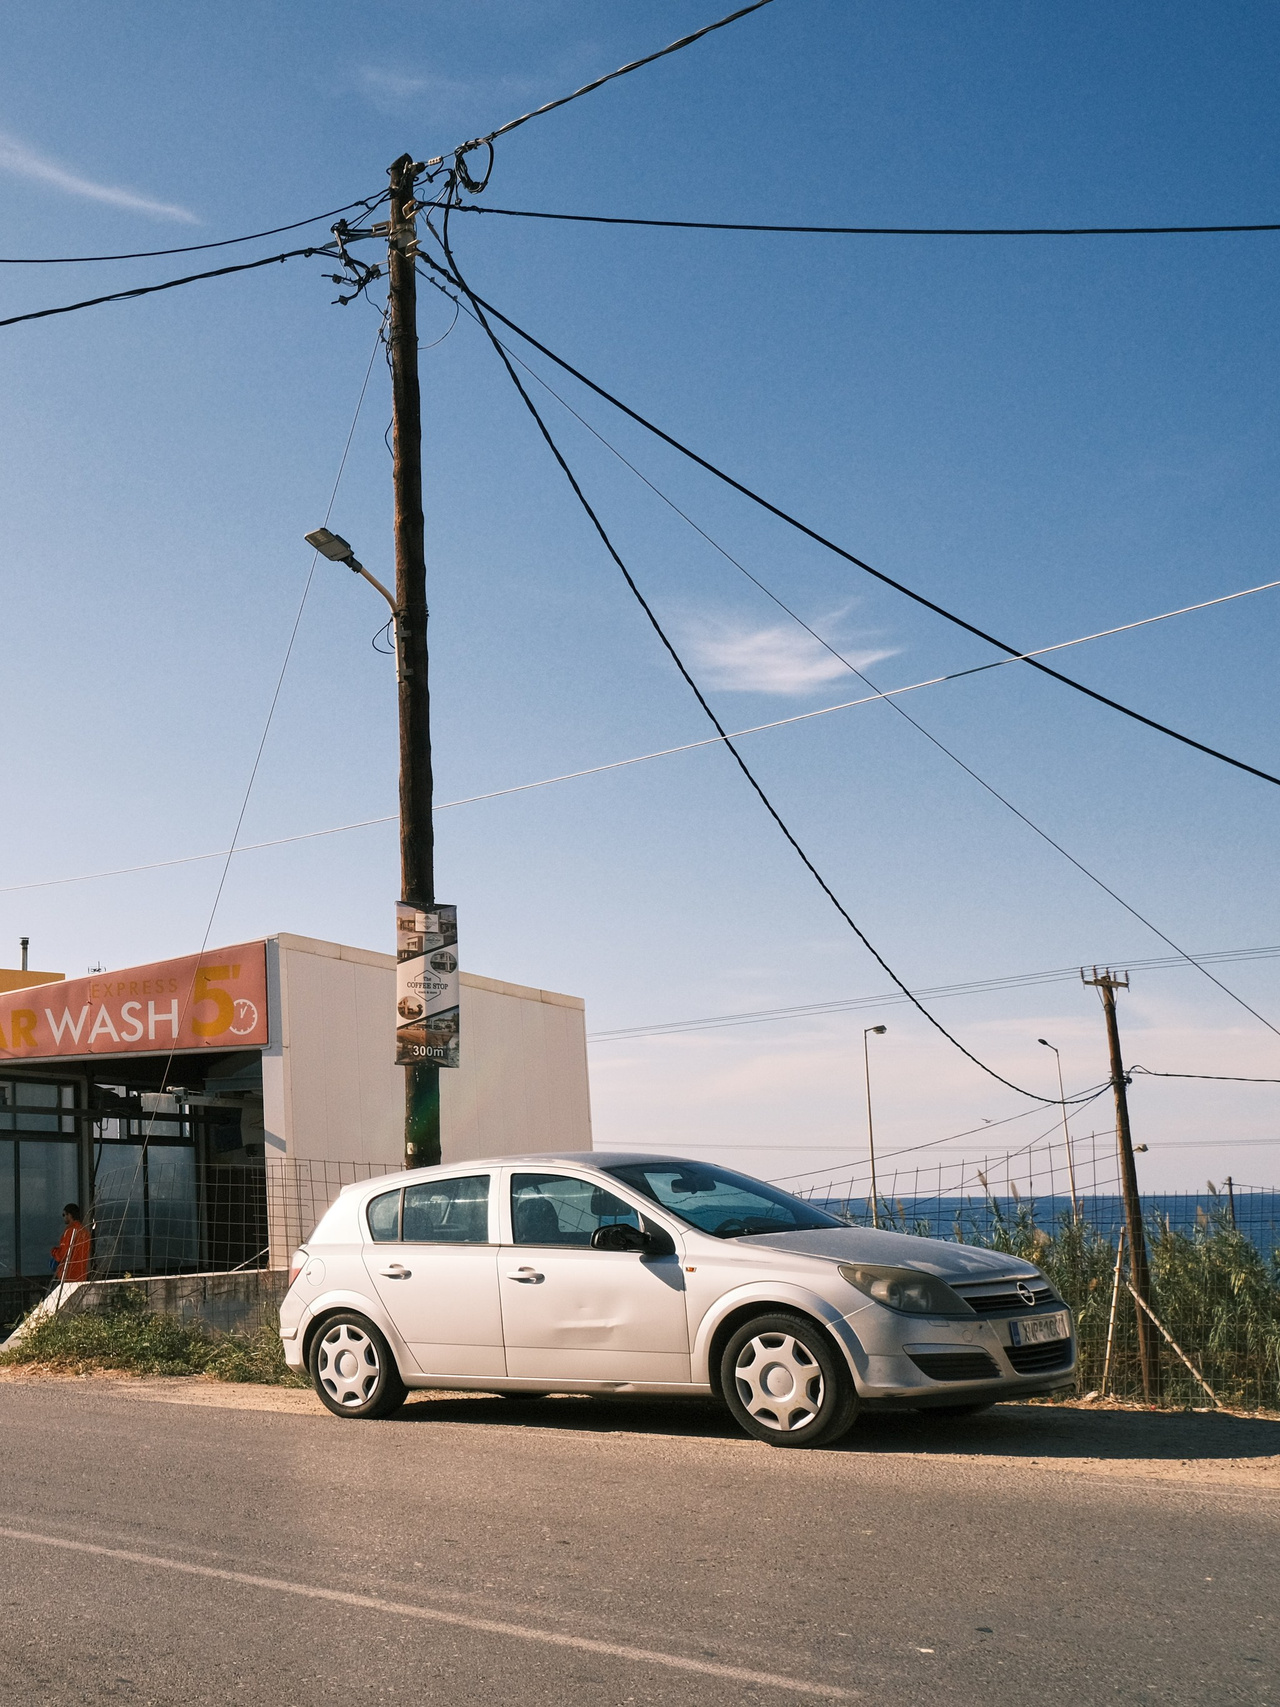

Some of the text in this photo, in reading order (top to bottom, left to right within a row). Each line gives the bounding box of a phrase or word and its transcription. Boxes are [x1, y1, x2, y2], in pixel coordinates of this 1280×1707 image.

[91, 978, 178, 999] EXPRESS
[406, 981, 449, 990] COFFEE STOP
[44, 998, 179, 1047] WASH
[412, 1045, 444, 1057] 300m
